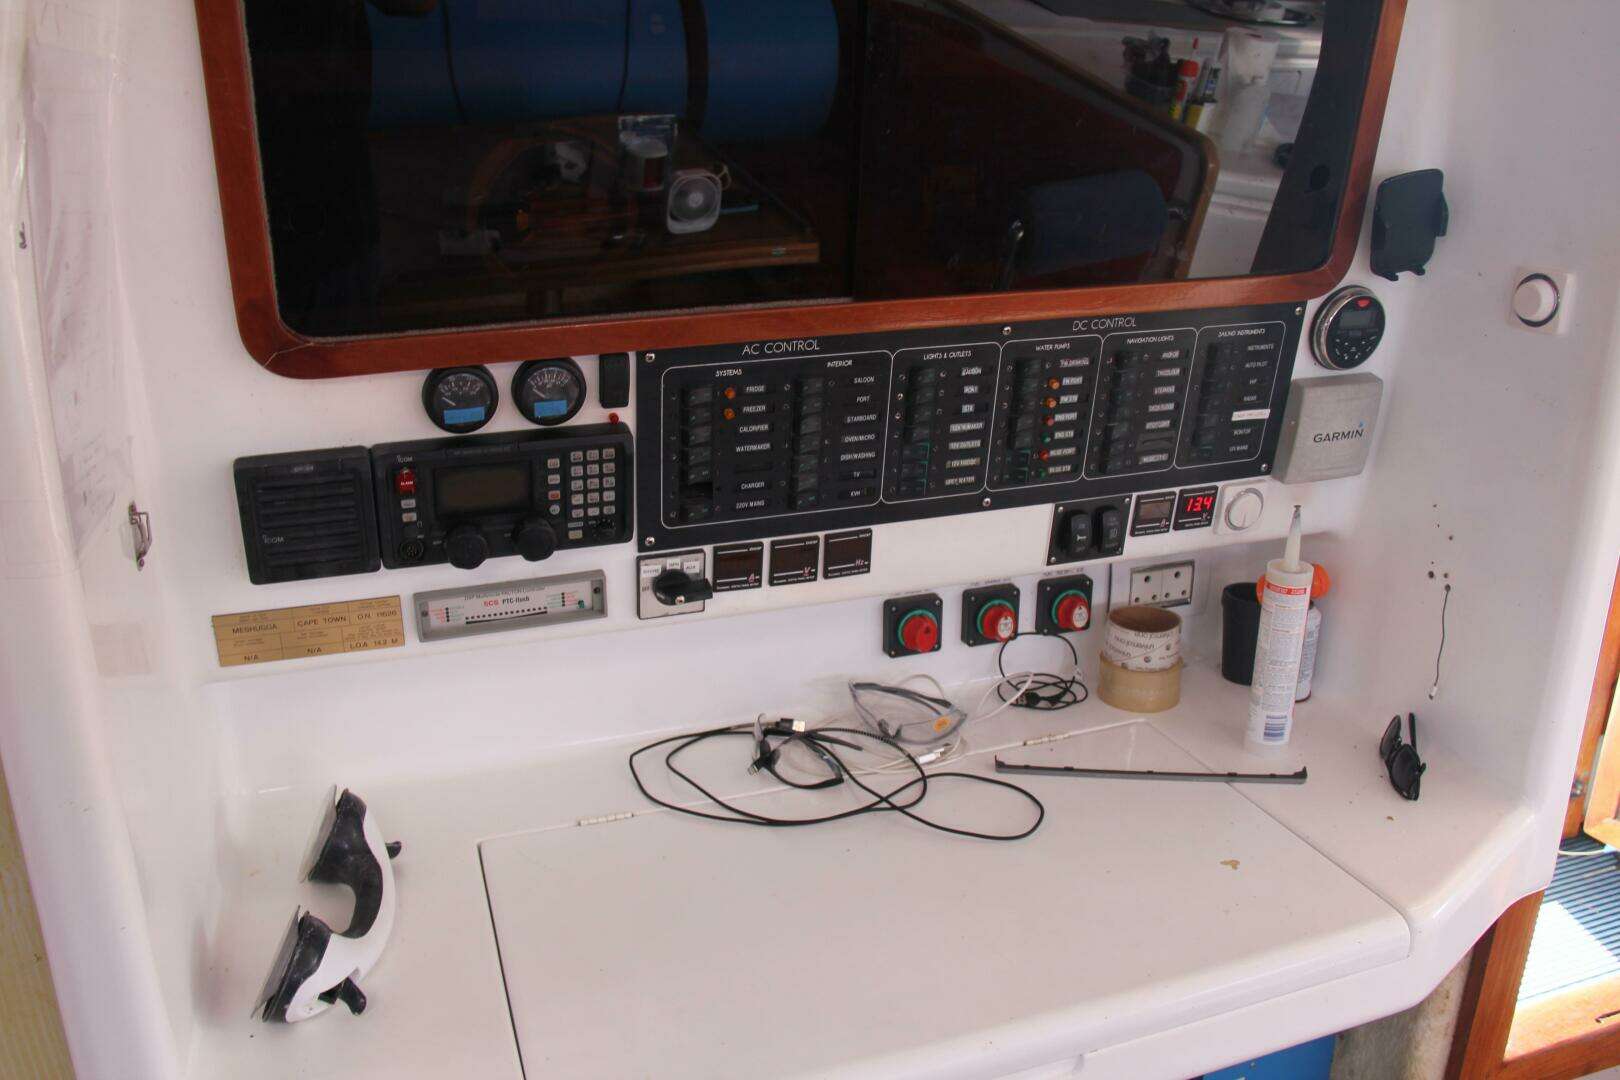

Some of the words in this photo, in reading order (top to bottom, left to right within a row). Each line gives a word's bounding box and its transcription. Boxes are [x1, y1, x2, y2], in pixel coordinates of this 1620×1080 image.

[1072, 320, 1088, 331] DC
[1091, 317, 1137, 329] CONTROL
[1237, 328, 1266, 337] INSTRUMENTS
[1127, 336, 1157, 344] NAVIGATION
[741, 344, 760, 356] AC
[764, 339, 821, 354] CONTROL
[1054, 342, 1071, 350] PUMPS
[923, 353, 941, 361] LIGHTS
[948, 350, 972, 358] OUTLETS
[826, 360, 853, 368] INTERIOR
[715, 368, 742, 377] SYSTEMS
[853, 375, 875, 384] SALOON
[746, 384, 765, 393] FRIDGE
[856, 395, 870, 404] PORT
[742, 404, 766, 413] FREEZER
[846, 413, 877, 423] STARBOARD
[739, 423, 769, 433] CALORIFIER
[844, 433, 876, 443] OVEN/MICRO
[1313, 428, 1365, 444] GARMIN
[735, 443, 771, 453] WATERMAKER
[741, 481, 765, 490] CHARGER
[735, 502, 748, 510] 220V
[749, 500, 765, 508] MAINS
[262, 534, 284, 545] ICOM
[296, 619, 319, 628] CAPE
[322, 616, 347, 625] TOWN
[232, 623, 278, 635] MESHUGGA
[243, 654, 260, 662] N/A
